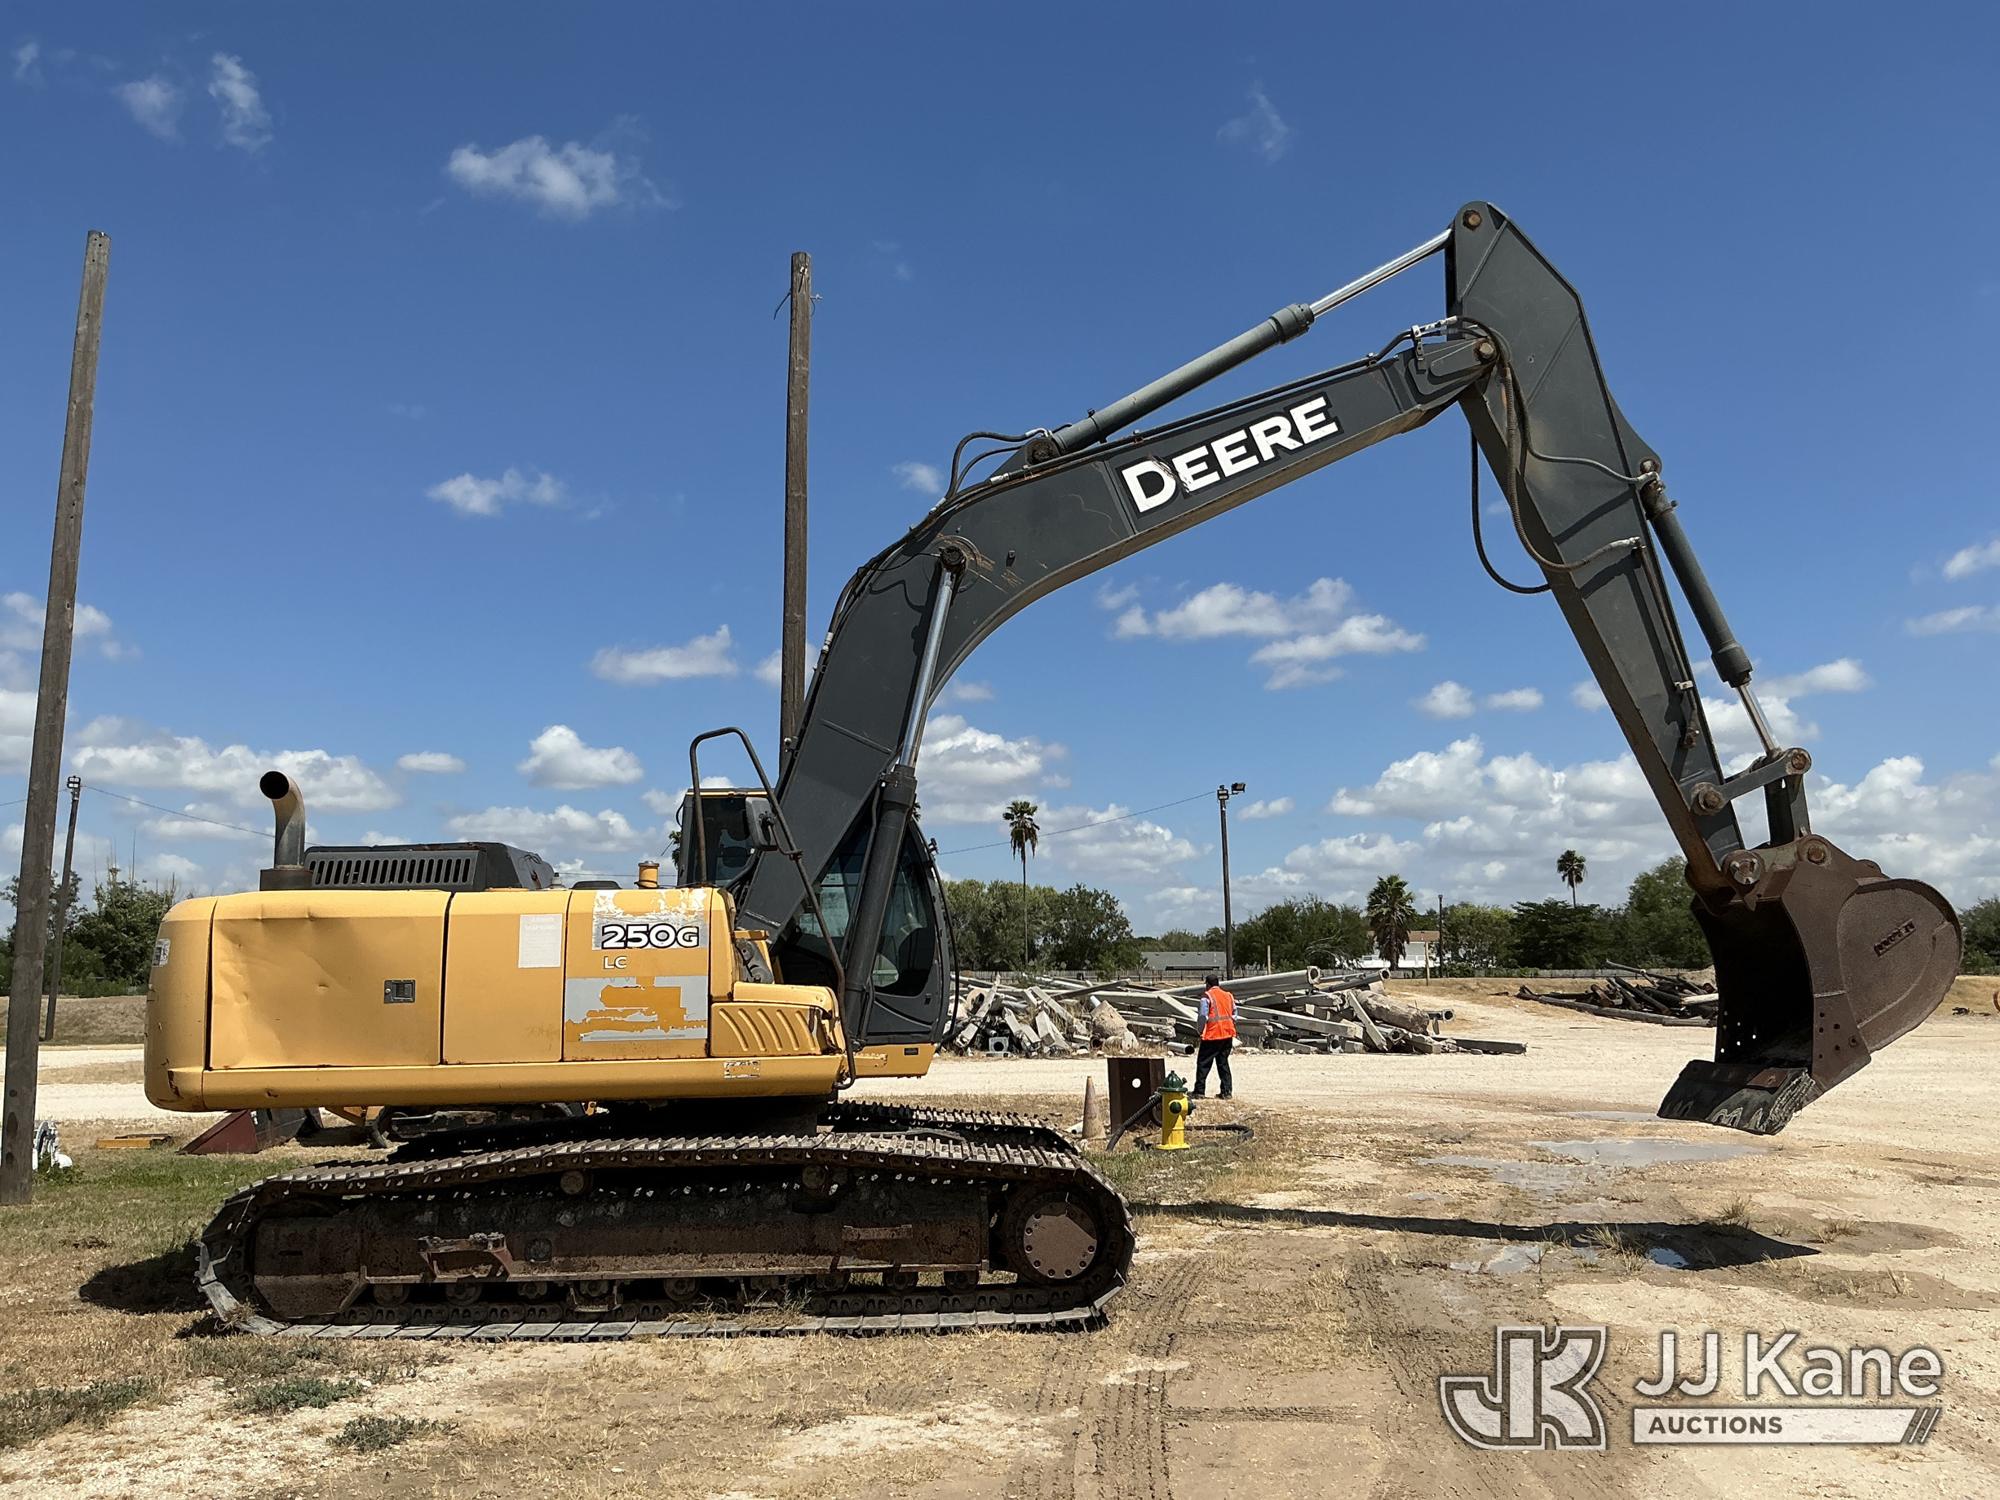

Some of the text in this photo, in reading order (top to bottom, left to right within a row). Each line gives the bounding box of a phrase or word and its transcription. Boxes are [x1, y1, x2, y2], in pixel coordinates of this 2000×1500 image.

[1121, 396, 1339, 513] DEERE
[602, 923, 699, 949] 250G
[604, 956, 628, 969] LC
